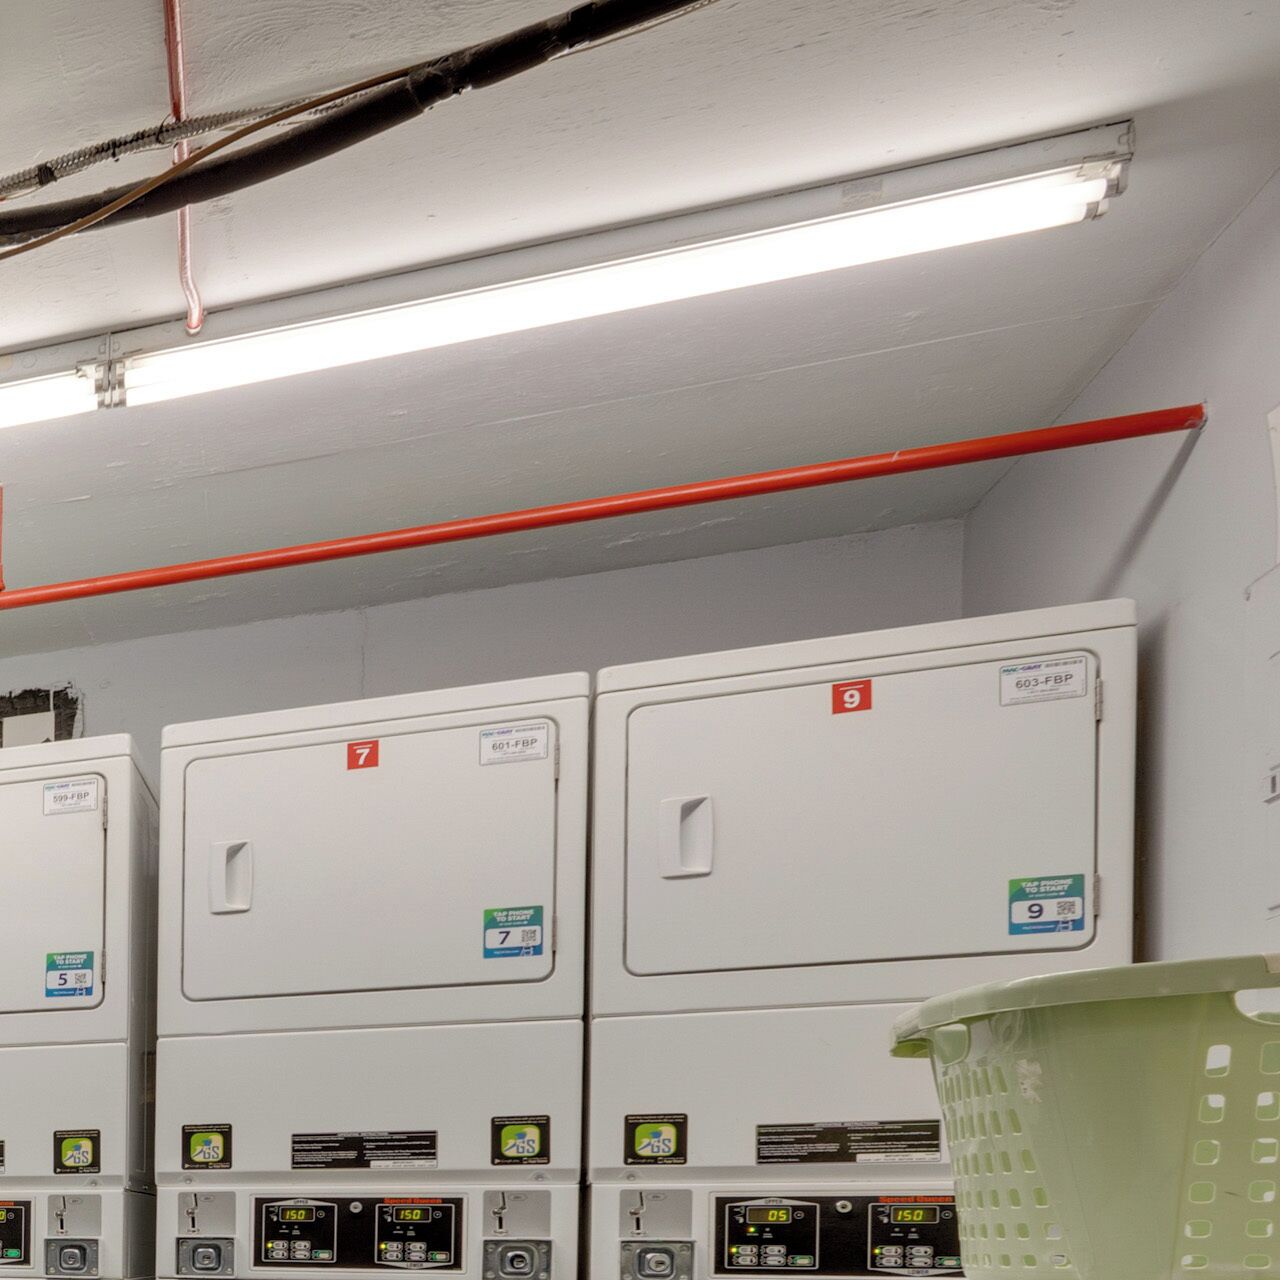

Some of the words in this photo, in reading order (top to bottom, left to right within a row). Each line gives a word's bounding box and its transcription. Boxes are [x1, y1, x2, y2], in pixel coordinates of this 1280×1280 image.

[1016, 674, 1073, 688] 603-FBP
[843, 690, 860, 709] 9
[492, 738, 538, 750] 601-FBP
[355, 747, 370, 765] 7
[1028, 903, 1043, 919] 9
[499, 931, 511, 944] 7
[58, 973, 67, 986] 5
[651, 1139, 671, 1153] GS
